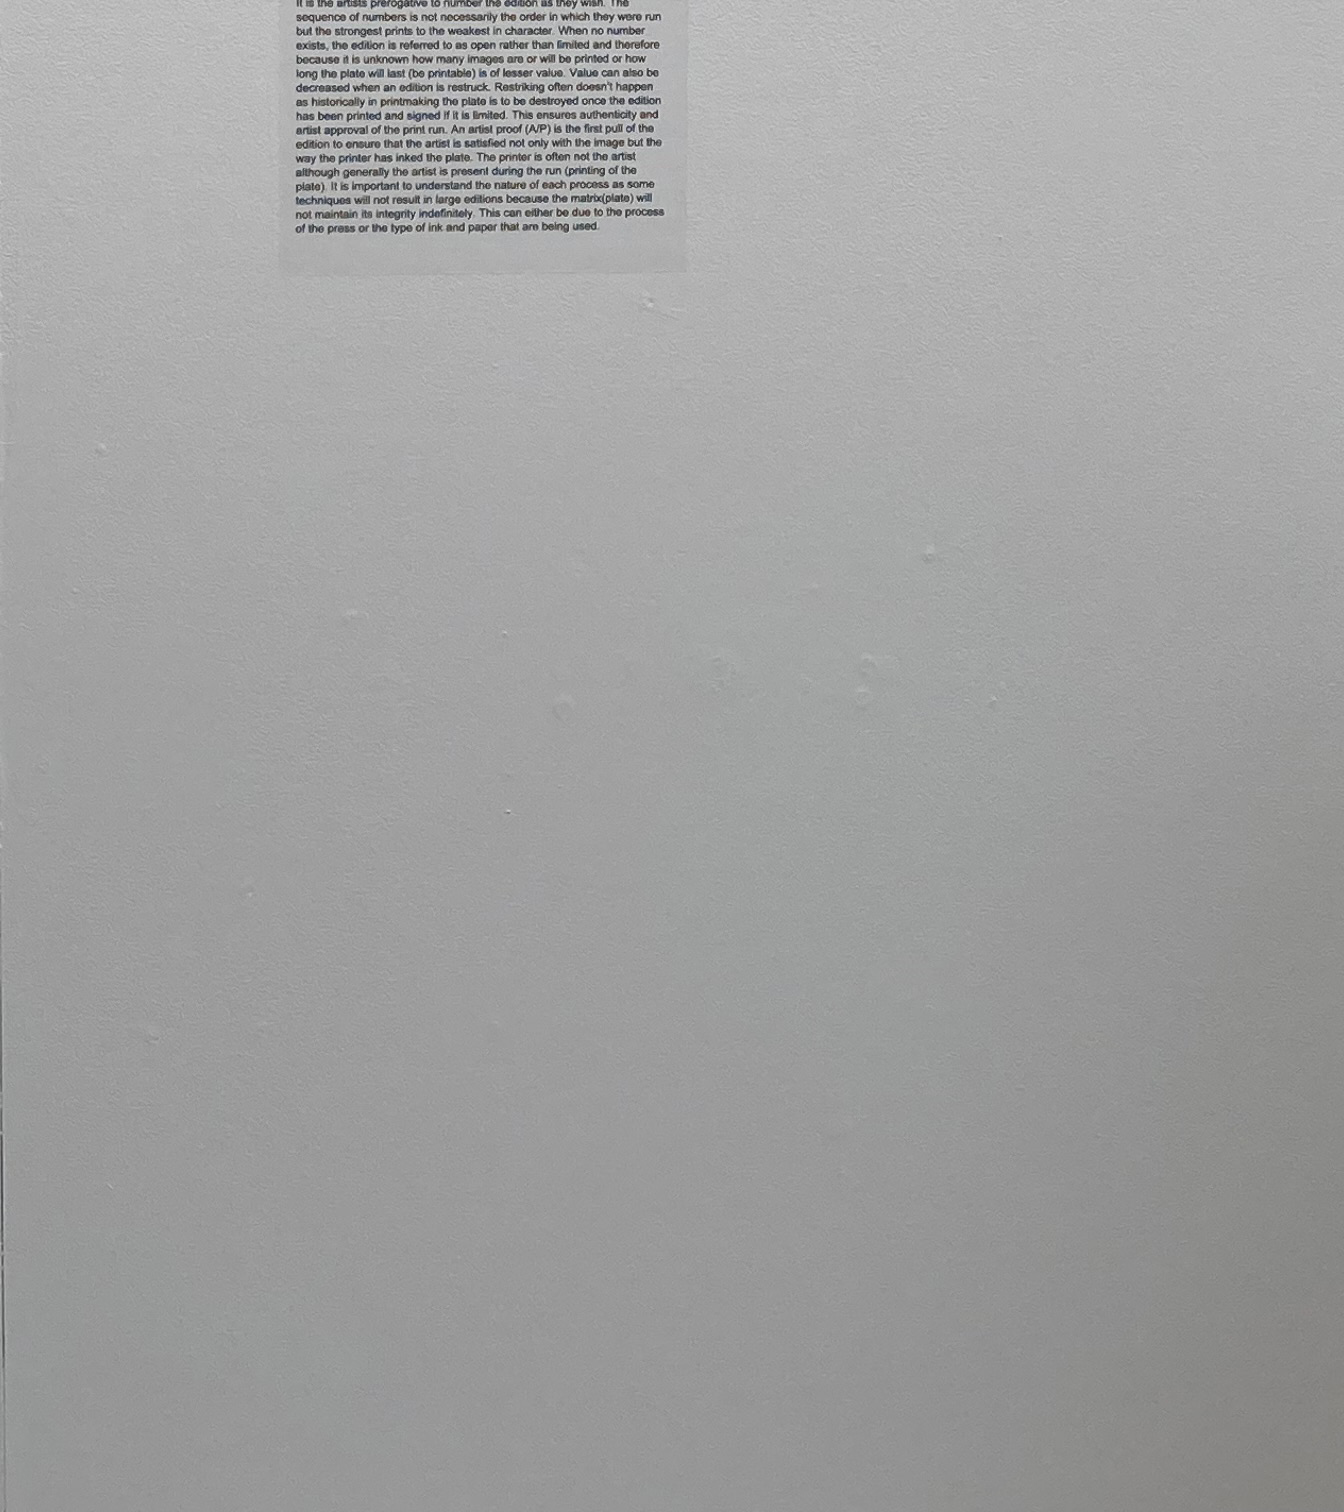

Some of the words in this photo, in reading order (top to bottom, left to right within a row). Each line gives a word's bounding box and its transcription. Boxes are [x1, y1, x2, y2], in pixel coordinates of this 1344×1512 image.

[540, 0, 553, 7] as
[295, 125, 321, 135] artist
[323, 124, 369, 136] approval
[370, 124, 382, 134] of
[383, 124, 400, 134] the
[402, 124, 425, 136] print
[427, 126, 448, 134] run.
[450, 123, 465, 134] An
[467, 124, 493, 134] artist
[495, 123, 522, 136] proof
[524, 123, 551, 135] (A/P)
[553, 123, 562, 133] is
[564, 123, 581, 133] the
[583, 123, 603, 133] first
[604, 123, 623, 135] pull
[625, 122, 636, 133] of
[637, 123, 654, 133] the
